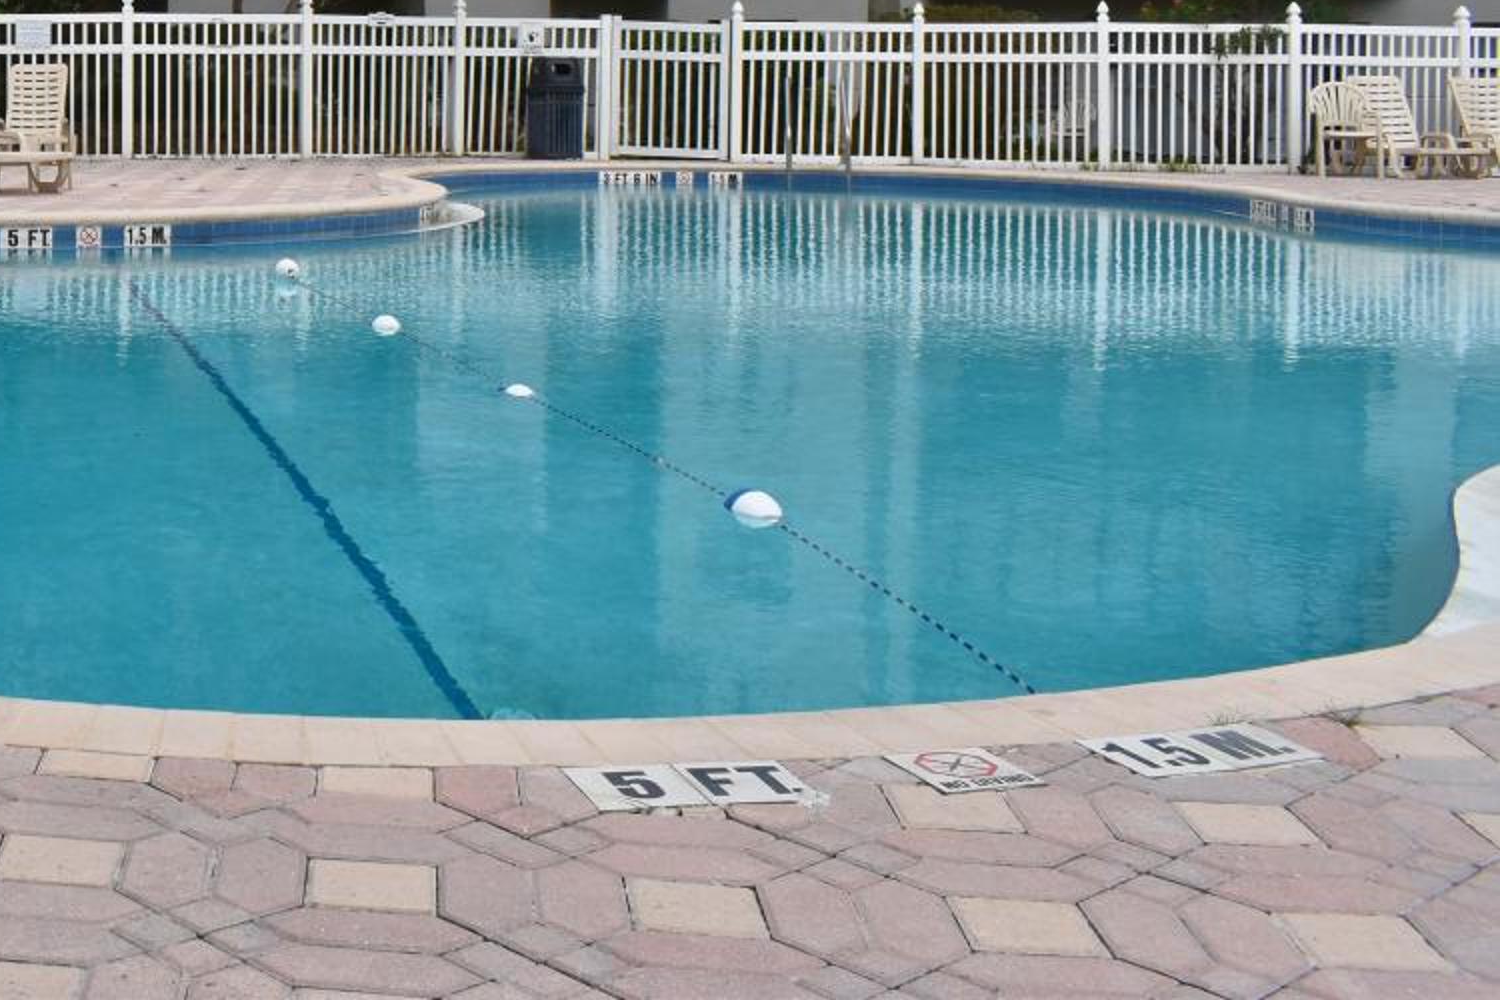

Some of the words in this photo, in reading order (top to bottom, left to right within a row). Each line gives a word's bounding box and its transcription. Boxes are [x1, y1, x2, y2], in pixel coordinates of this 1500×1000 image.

[7, 229, 19, 247] 5
[127, 227, 147, 245] 1.5
[1102, 737, 1210, 768] 1.5
[1189, 730, 1298, 760] M.
[601, 771, 666, 799] 5
[686, 766, 803, 796] FT.
